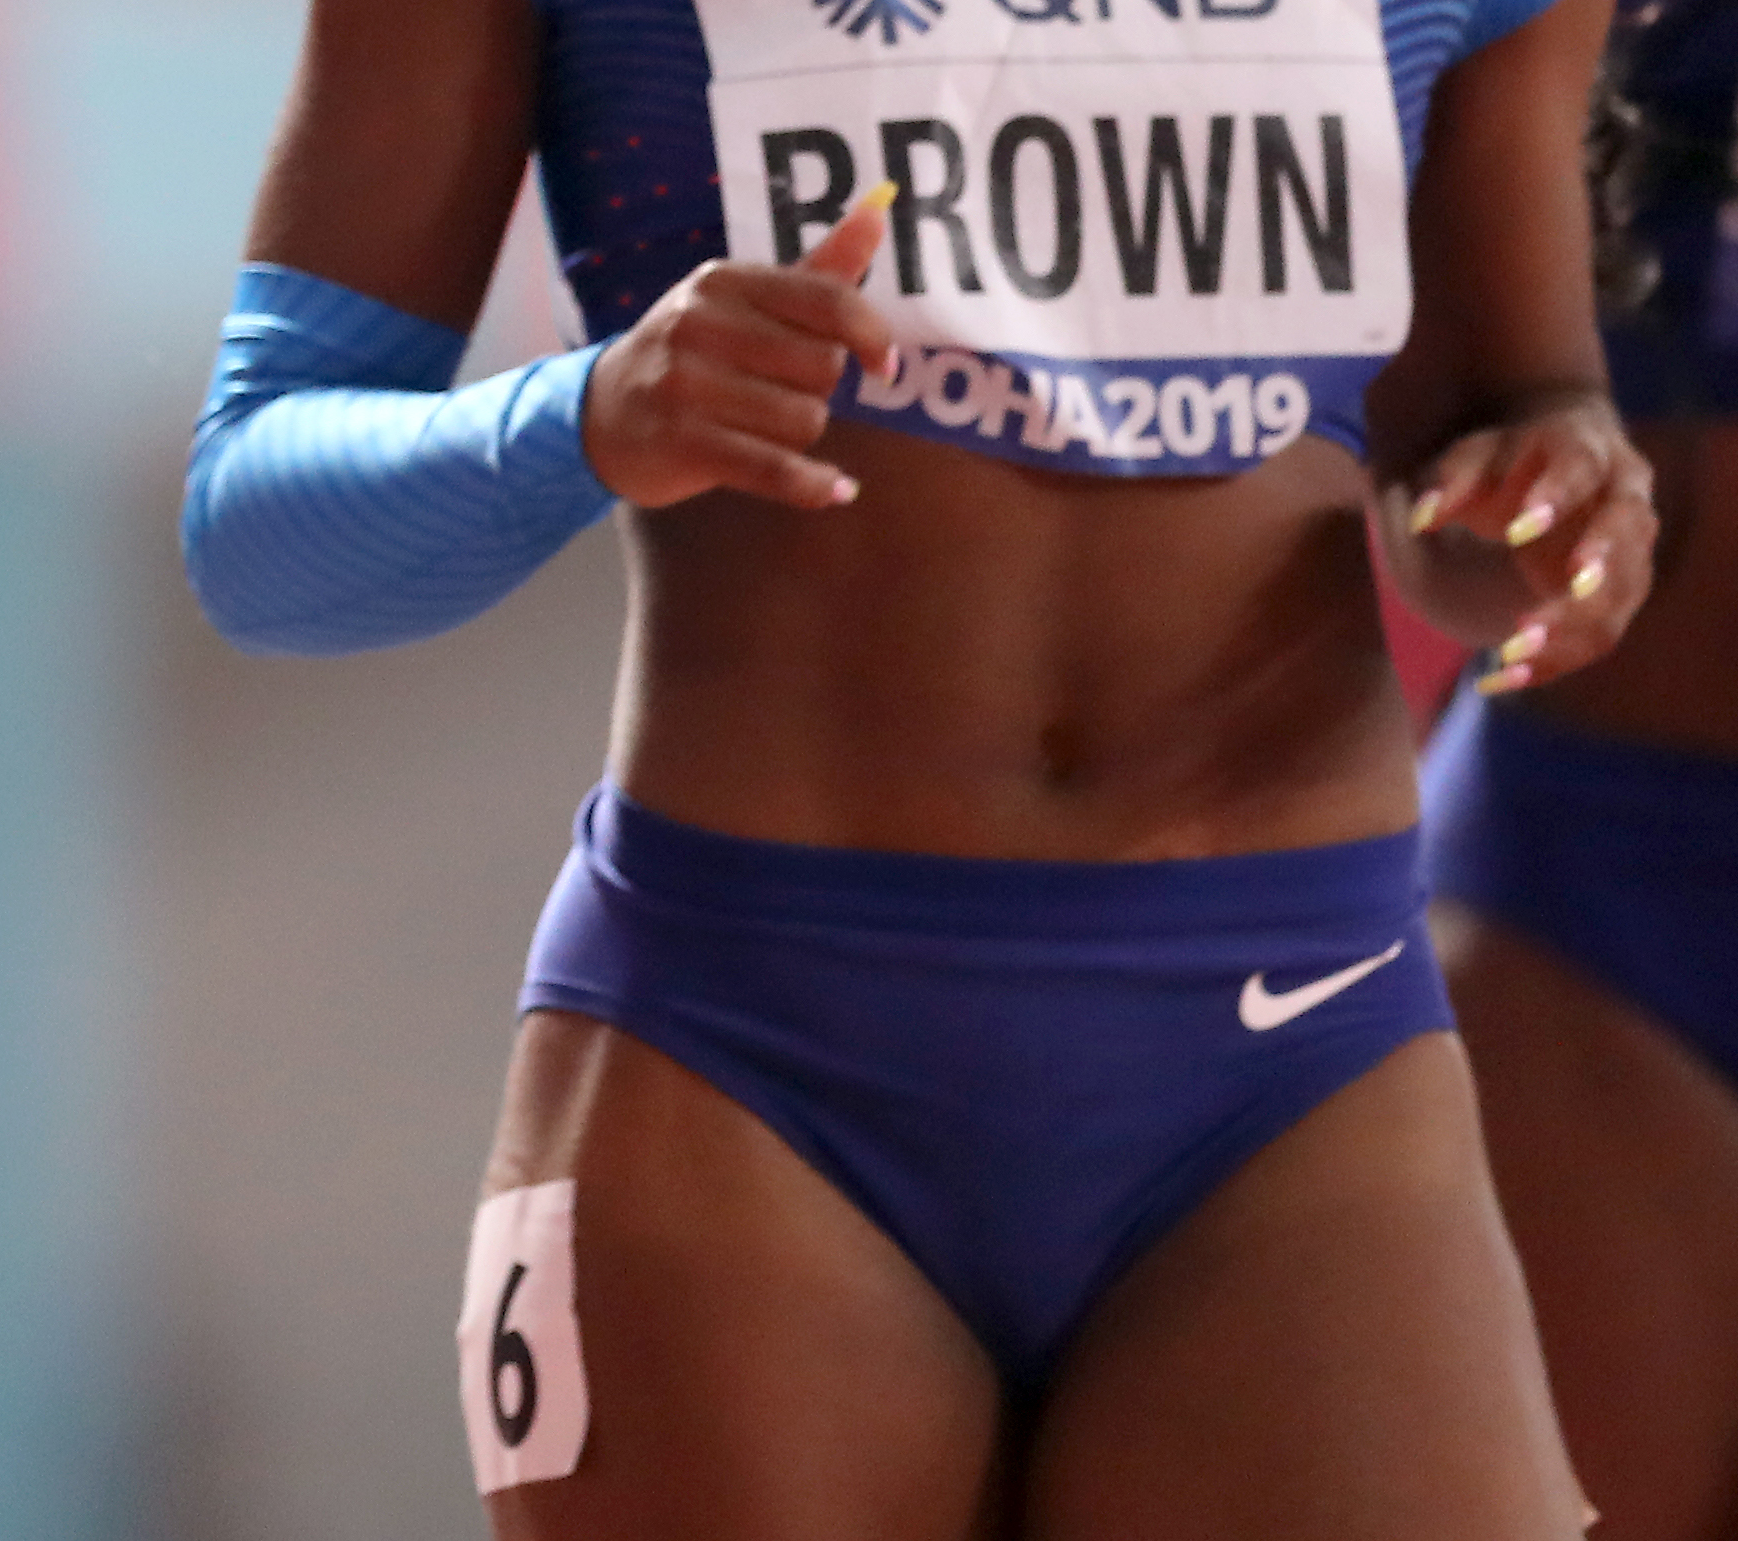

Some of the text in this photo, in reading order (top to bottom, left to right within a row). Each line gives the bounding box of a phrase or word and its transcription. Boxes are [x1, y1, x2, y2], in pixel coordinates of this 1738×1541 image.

[759, 112, 1355, 301] BROWN
[854, 346, 1312, 460] DOHA2019
[489, 1262, 539, 1447] 6
